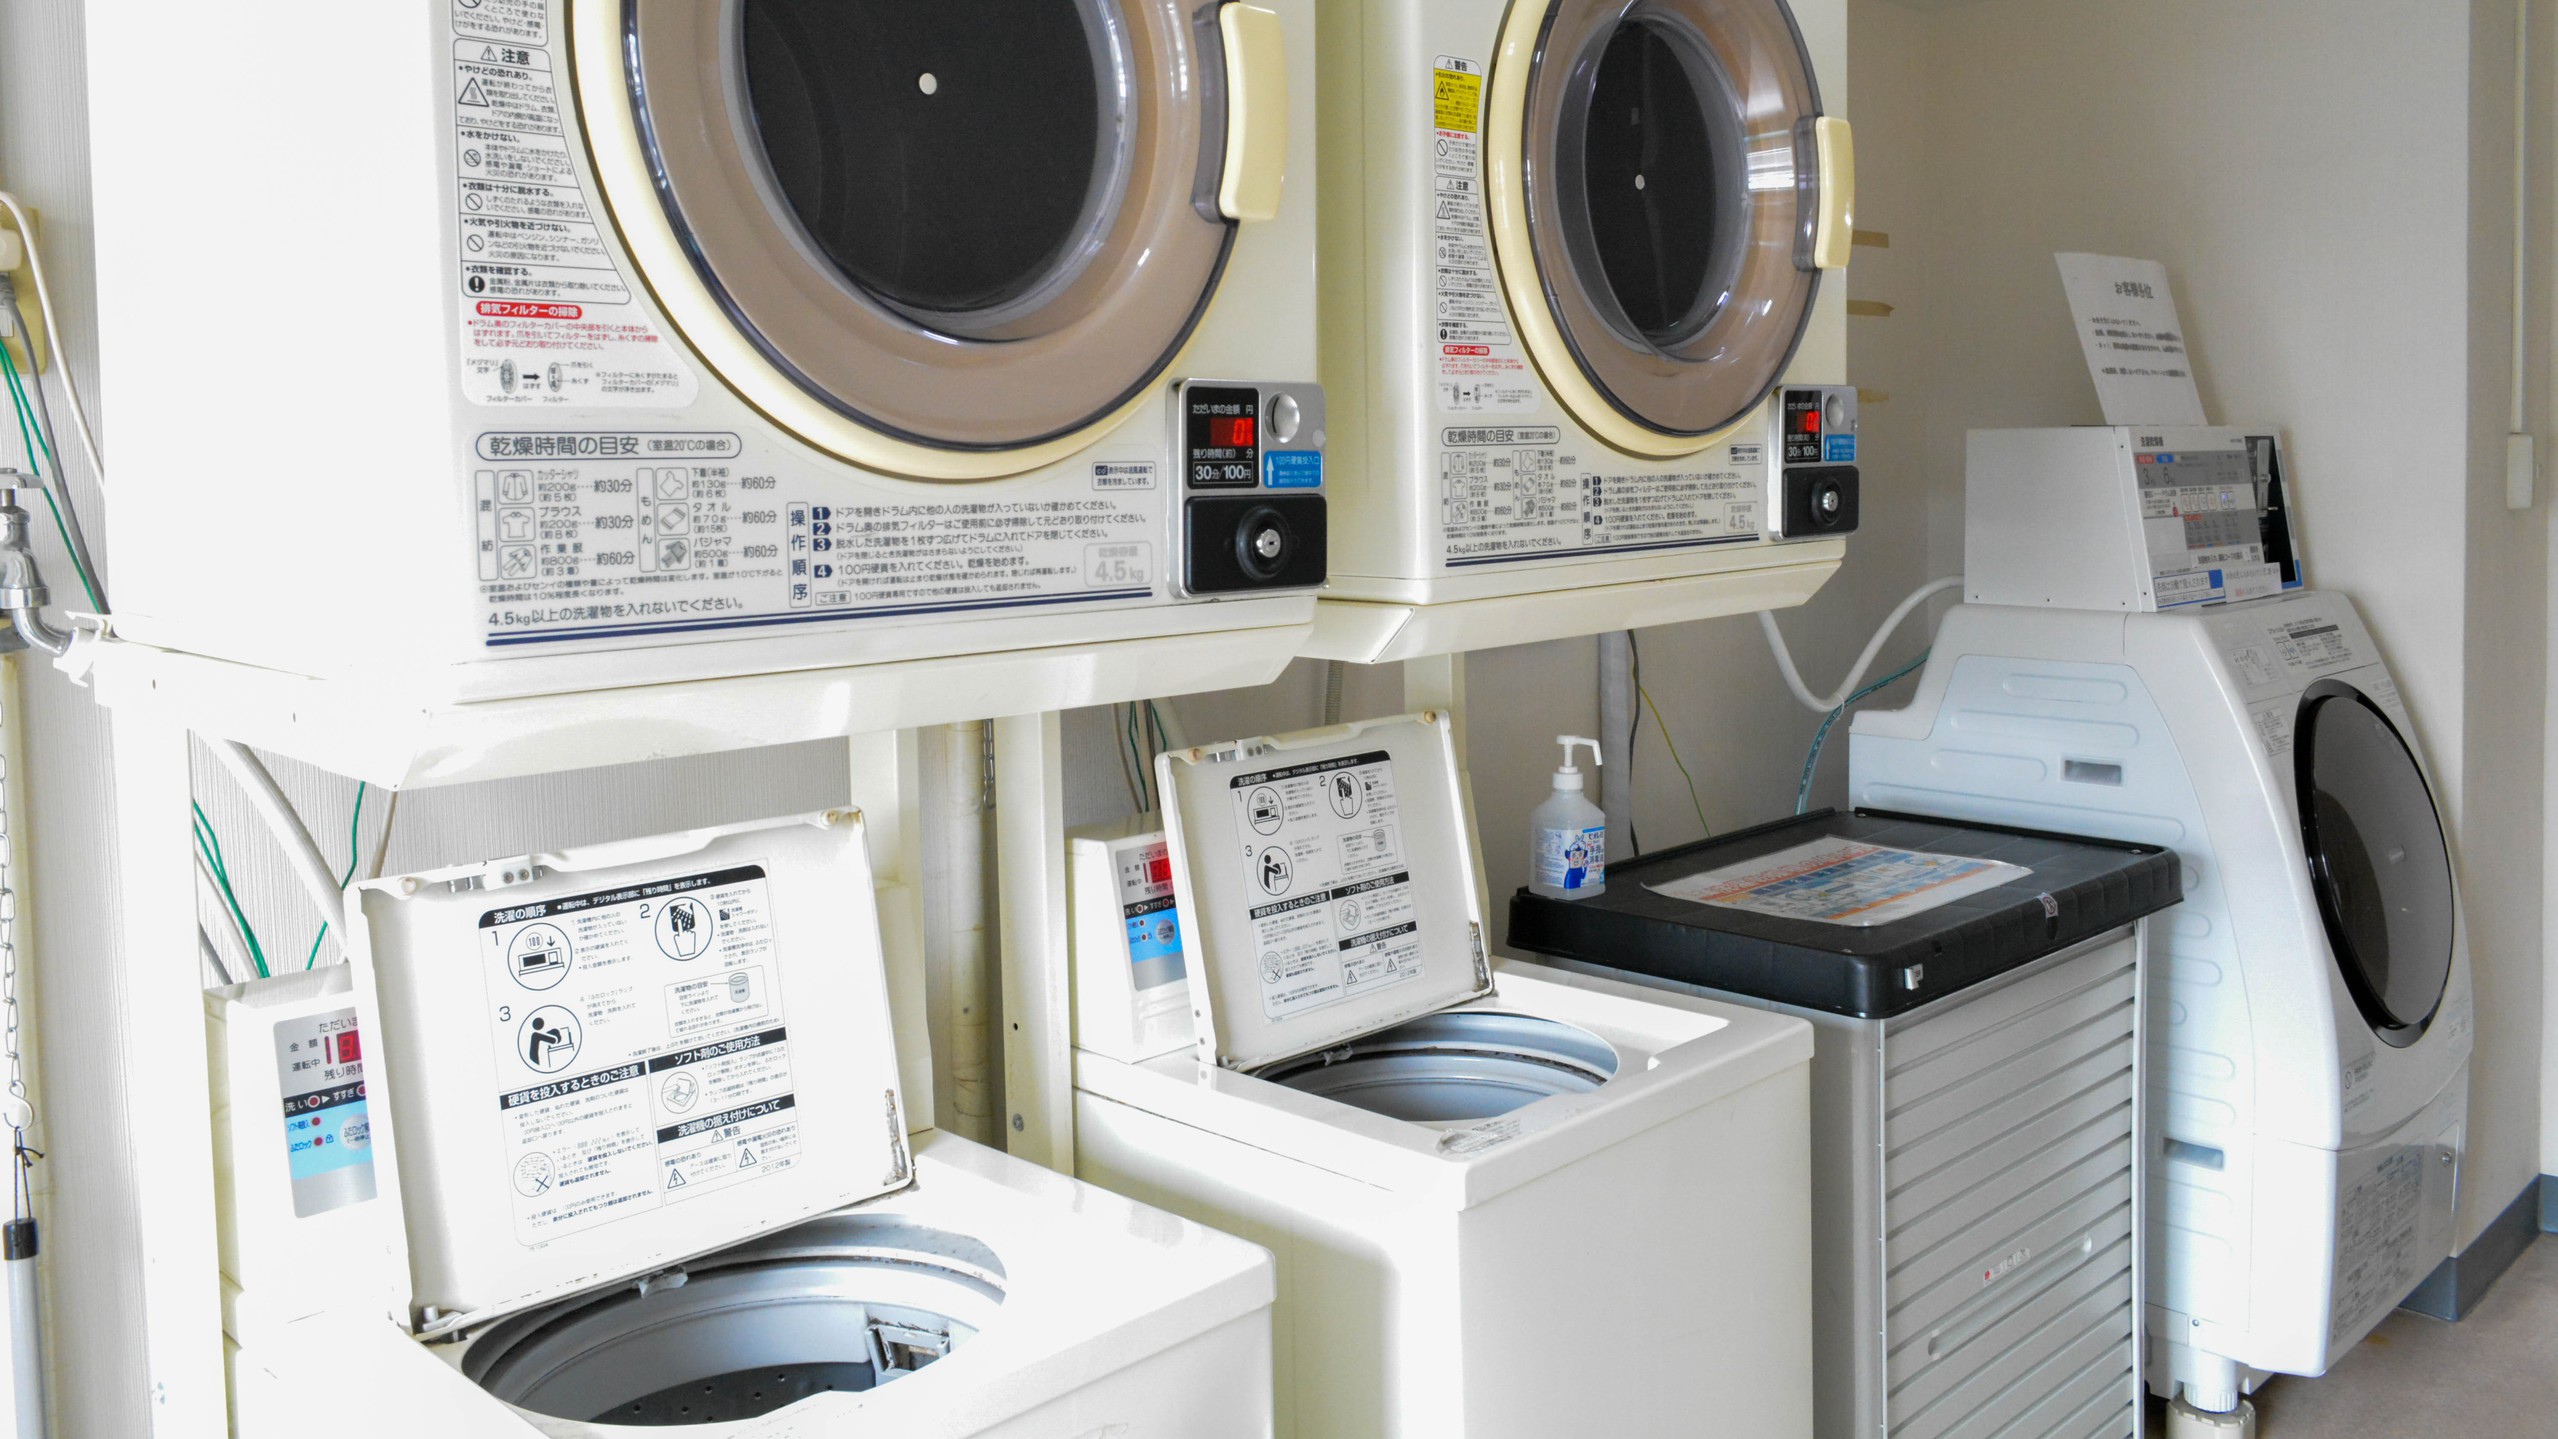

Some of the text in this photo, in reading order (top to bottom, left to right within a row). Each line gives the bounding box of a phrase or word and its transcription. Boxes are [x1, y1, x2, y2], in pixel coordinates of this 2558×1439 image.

[501, 47, 530, 66] 注意
[464, 65, 533, 81] やけどの恐れあり。
[466, 129, 520, 142] 水をかけない。
[468, 182, 554, 197] 衣類は十分に脱水する。
[1455, 180, 1469, 191] 注意
[469, 218, 571, 233] 火気や引火物を近づけない。
[471, 265, 532, 276] 衣類を確認する。
[480, 302, 579, 318] 排気フィルターの掃除
[1192, 403, 1254, 415] ただいまの金額 円
[1447, 429, 1514, 443] 乾燥時間の目安
[490, 436, 640, 457] 乾燥時間の目安
[1245, 449, 1254, 459] 分
[594, 479, 632, 493] 約30分
[741, 476, 776, 490] 約60分
[539, 506, 582, 518] ブラウス
[742, 510, 777, 524] 約60分
[595, 515, 634, 529] 約30分
[1729, 515, 1746, 529] 4.5
[816, 524, 825, 535] 2
[694, 536, 732, 547] パジャマ
[817, 539, 826, 551] 3
[596, 551, 635, 566] 約60分
[743, 545, 778, 558] 約60分
[790, 509, 808, 601] 操作順序
[816, 565, 827, 577] 4
[1095, 560, 1144, 582] 4.5 kg
[488, 596, 744, 626] 4.5kg以上の洗濯物を入れないでください。
[1319, 775, 1327, 787] 2
[1245, 844, 1253, 858] 3
[1126, 878, 1143, 888] 運転中
[494, 903, 547, 924] 洗濯の順序
[639, 903, 651, 920] 2
[491, 930, 500, 947] 1
[499, 1006, 512, 1022] 3
[674, 1035, 761, 1065] ソフト剤のご使用方法
[292, 1058, 321, 1072] 運転中
[508, 1064, 640, 1107] 硬貨を投入するときのご注意
[332, 1086, 354, 1101] すすぎ
[678, 1100, 781, 1137] 洗濯機の据え付けについて
[723, 1125, 741, 1138] 警告
